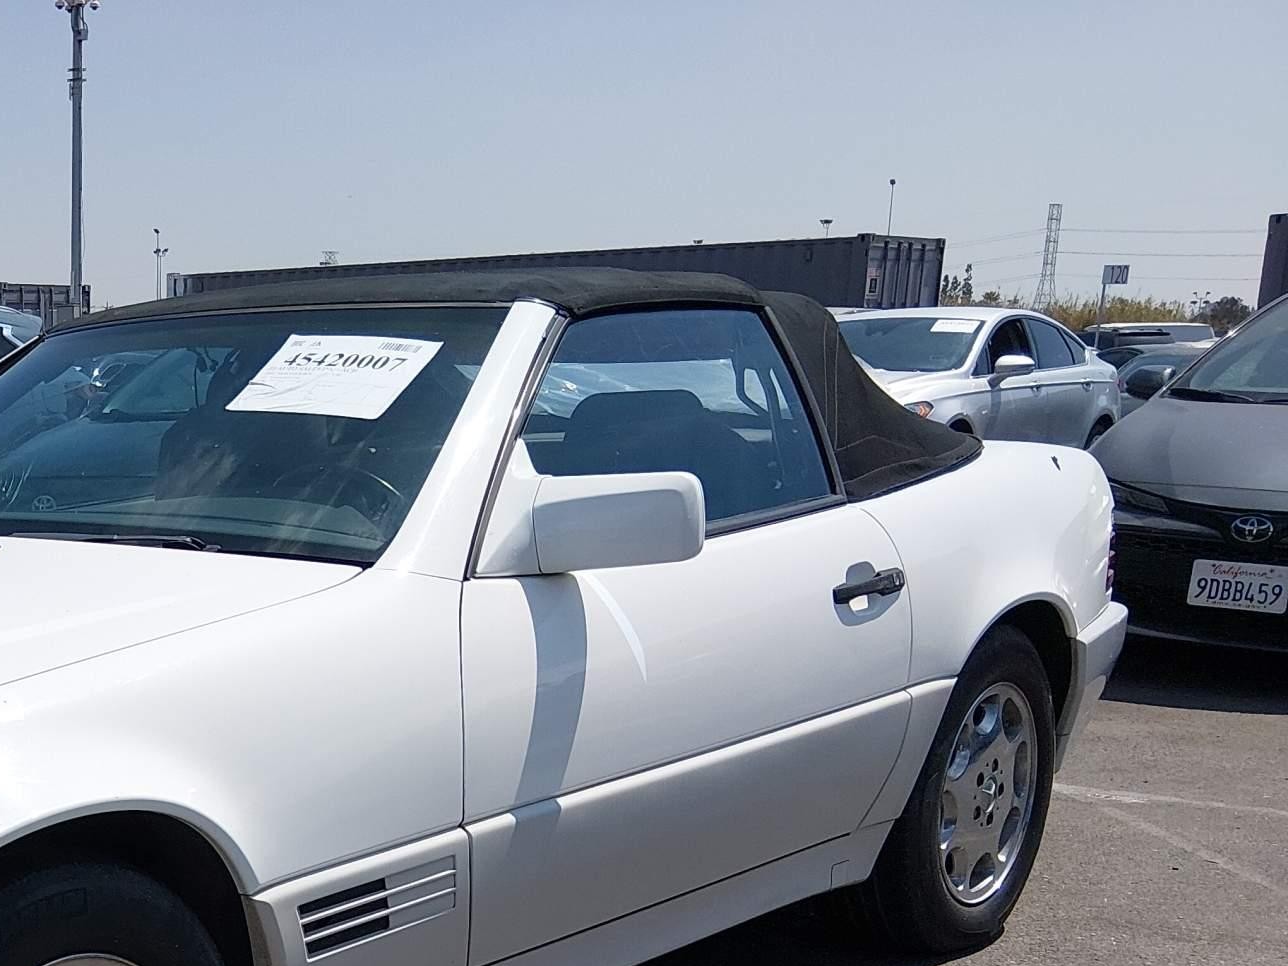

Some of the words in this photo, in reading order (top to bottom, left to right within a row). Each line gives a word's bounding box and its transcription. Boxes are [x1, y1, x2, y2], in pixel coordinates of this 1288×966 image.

[284, 352, 409, 373] 45420007
[1213, 563, 1272, 579] California
[1194, 577, 1283, 606] 9DBB459
